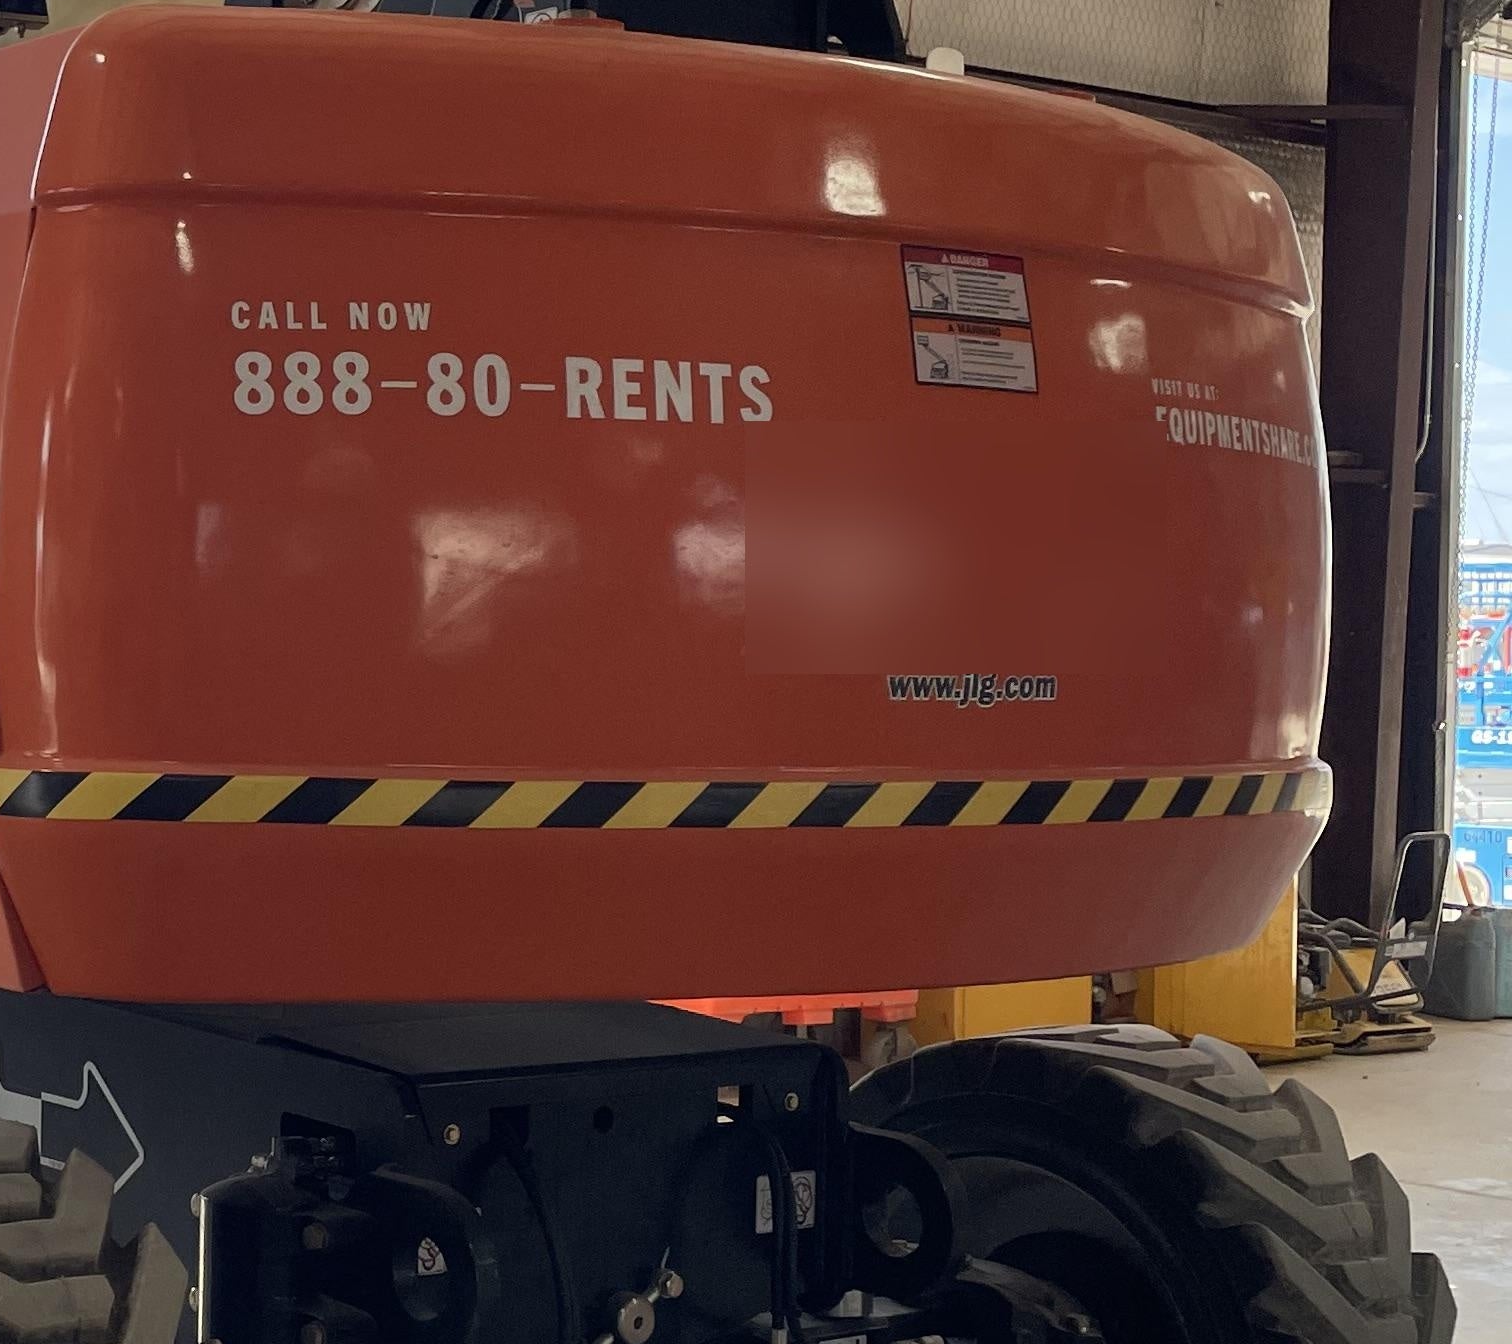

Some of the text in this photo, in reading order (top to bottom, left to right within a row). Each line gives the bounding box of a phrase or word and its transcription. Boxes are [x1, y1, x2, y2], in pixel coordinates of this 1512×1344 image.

[231, 300, 431, 331] CALL NOW
[1151, 377, 1183, 397] VISIT
[1187, 382, 1201, 400] US
[888, 674, 1057, 708] www.jlg.com
